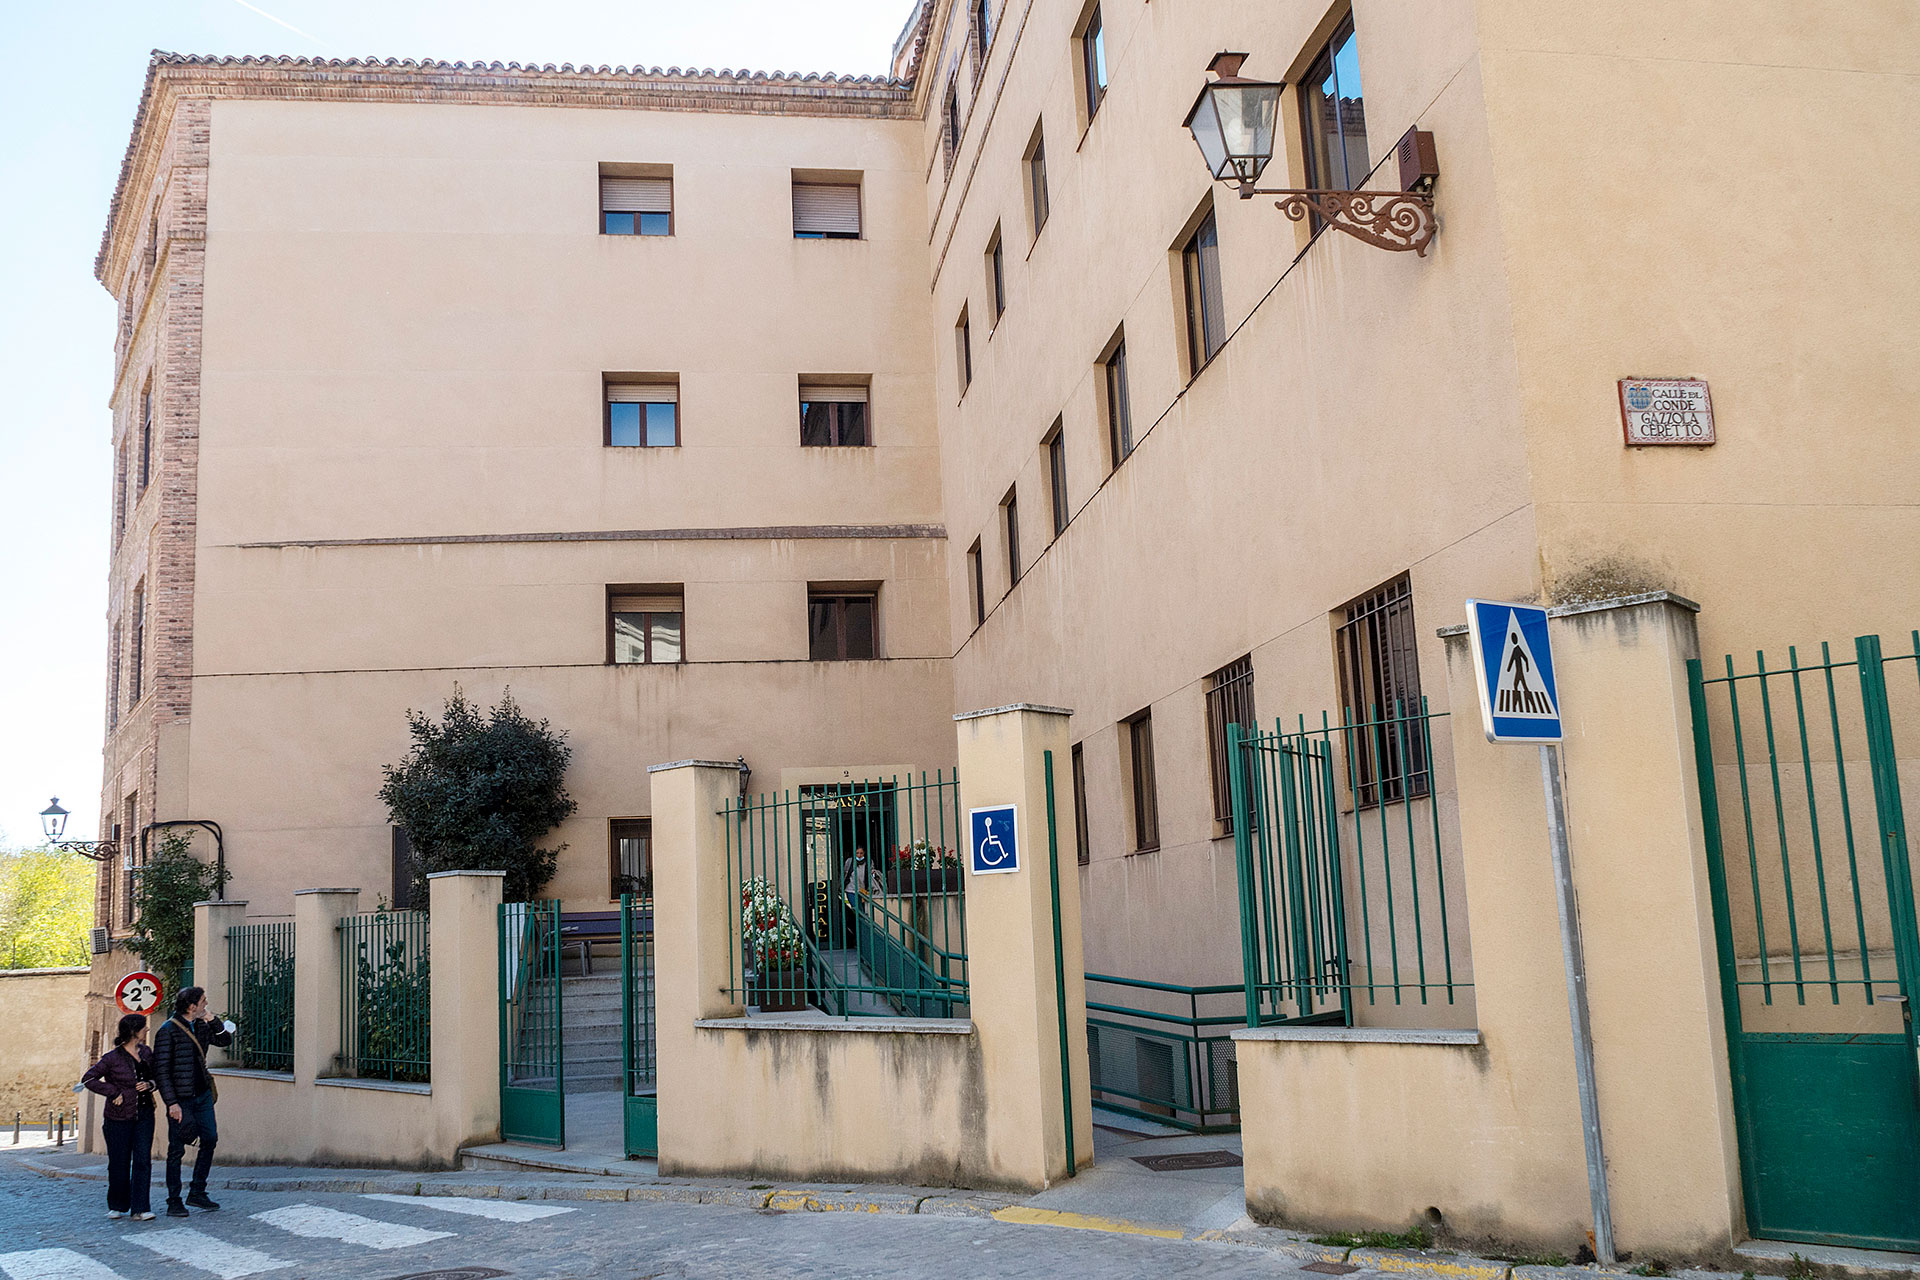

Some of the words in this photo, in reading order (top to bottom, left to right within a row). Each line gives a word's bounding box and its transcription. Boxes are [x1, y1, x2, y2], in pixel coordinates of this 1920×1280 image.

[1652, 389, 1687, 399] CALLE
[1654, 400, 1696, 411] CONDE
[1641, 412, 1699, 424] GAZZOLA
[843, 770, 850, 778] 2
[822, 793, 870, 808] CASA
